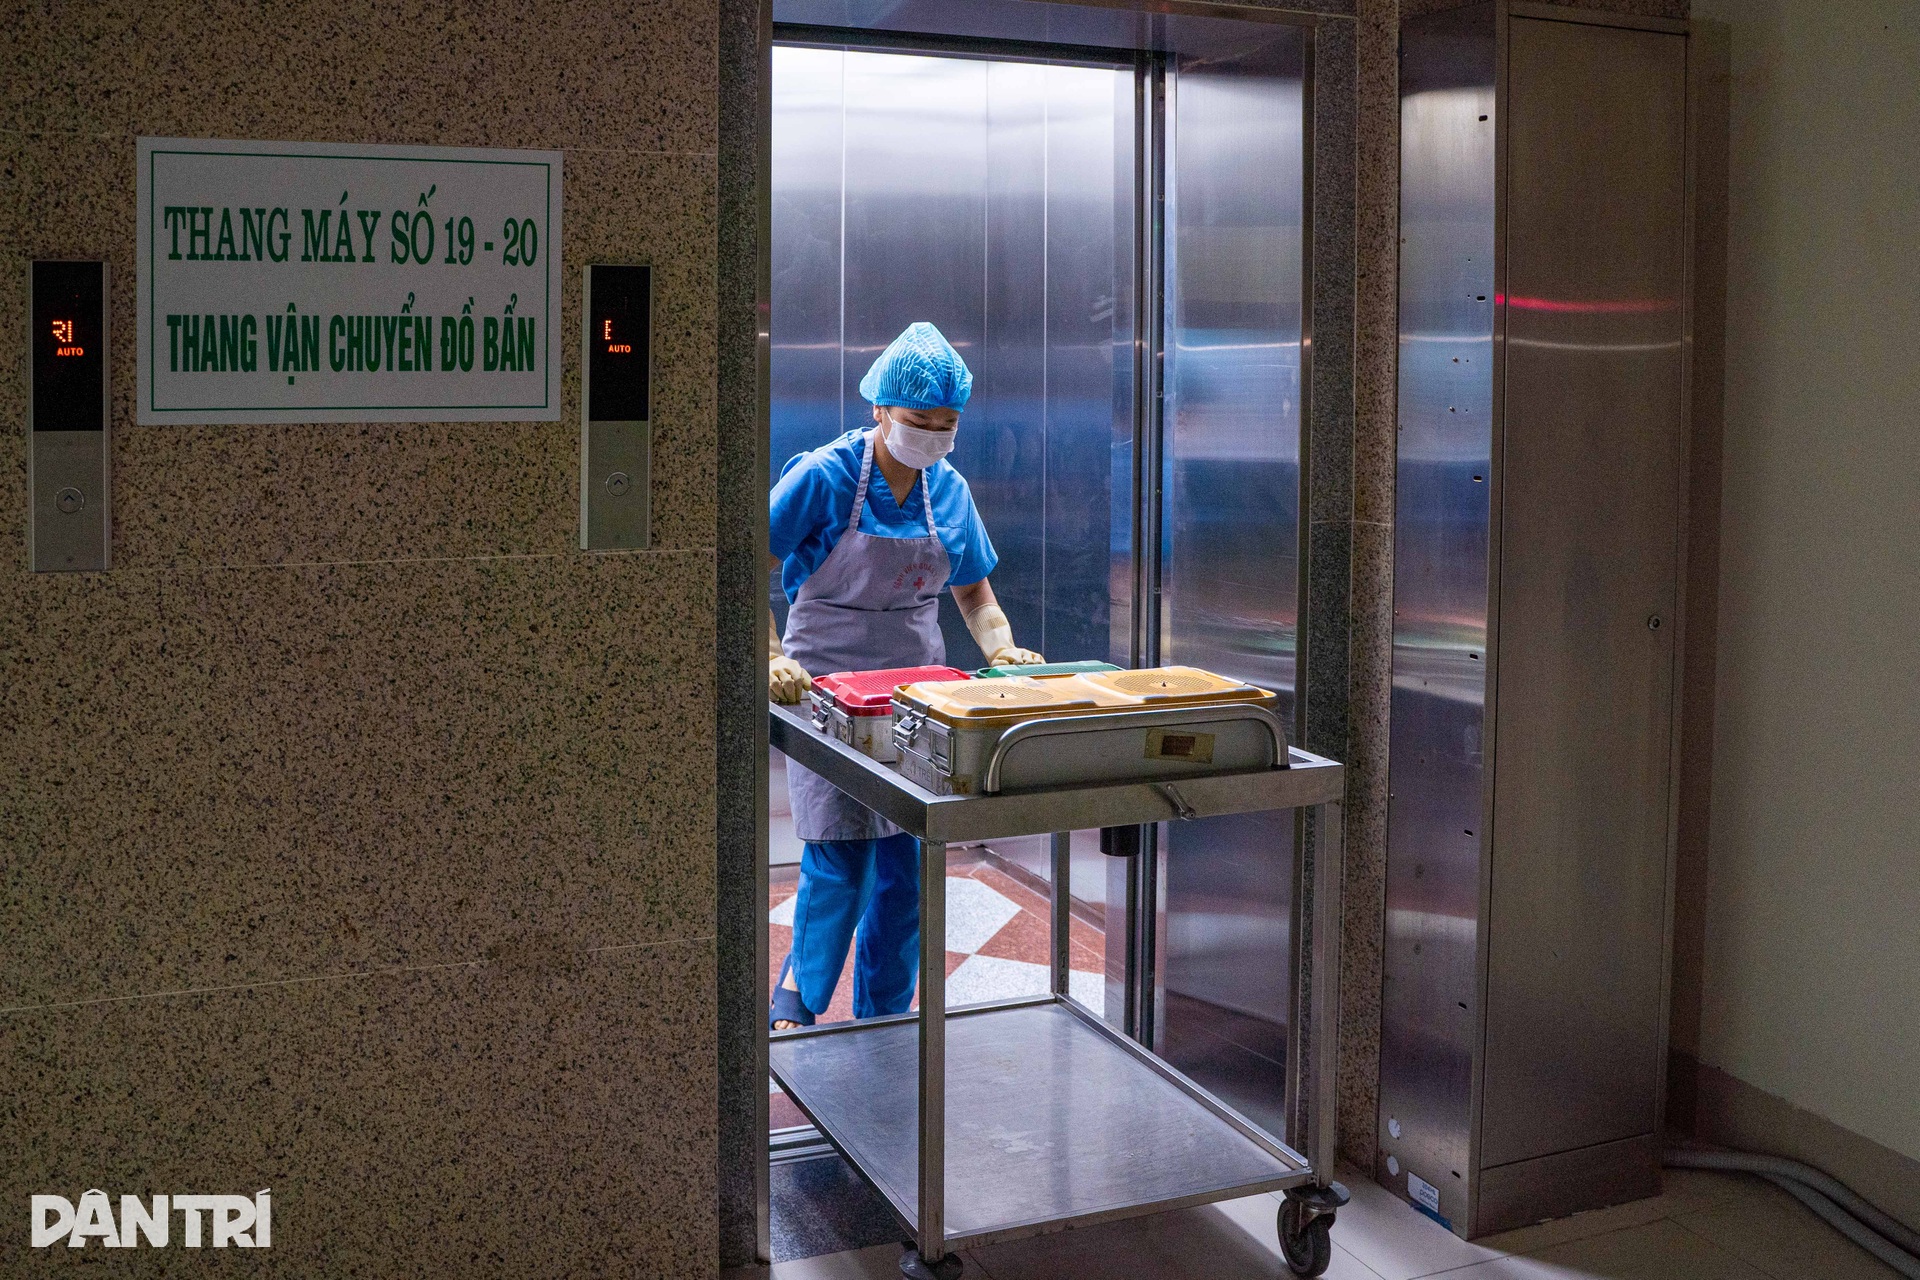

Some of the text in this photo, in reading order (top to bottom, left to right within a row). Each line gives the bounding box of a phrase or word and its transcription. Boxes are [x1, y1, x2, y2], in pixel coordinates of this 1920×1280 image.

[164, 183, 538, 267] THANG MÁY SỐ 19 - 20
[57, 346, 84, 356] AUTO
[166, 291, 535, 385] THANG VẬN CHUYỂN ĐỒ BẨN
[608, 344, 631, 353] AUTO
